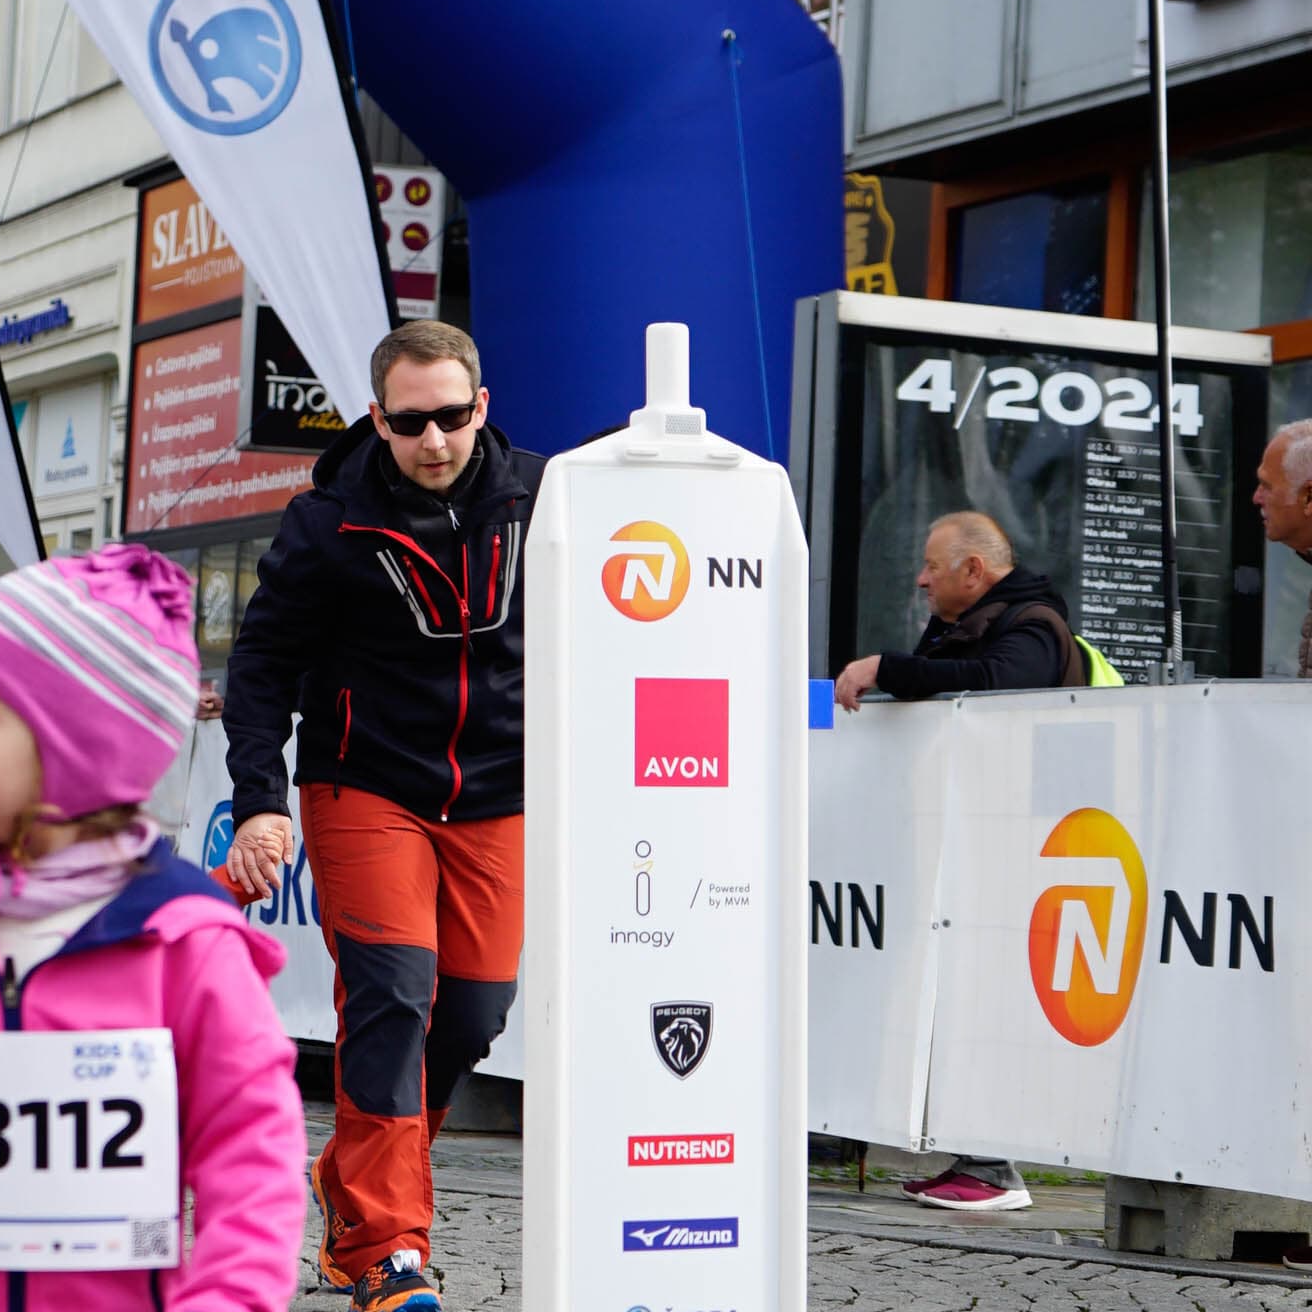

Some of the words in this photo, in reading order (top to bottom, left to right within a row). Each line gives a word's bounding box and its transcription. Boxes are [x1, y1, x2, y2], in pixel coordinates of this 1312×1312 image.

[708, 557, 763, 589] NN
[644, 757, 719, 779] AVON
[709, 883, 751, 894] Powered
[709, 896, 721, 909] by
[725, 897, 750, 907] MVM
[610, 926, 675, 948] innogy
[1160, 890, 1275, 972] NN
[656, 1007, 708, 1016] PEUGEOT
[633, 1139, 730, 1161] NUTREND
